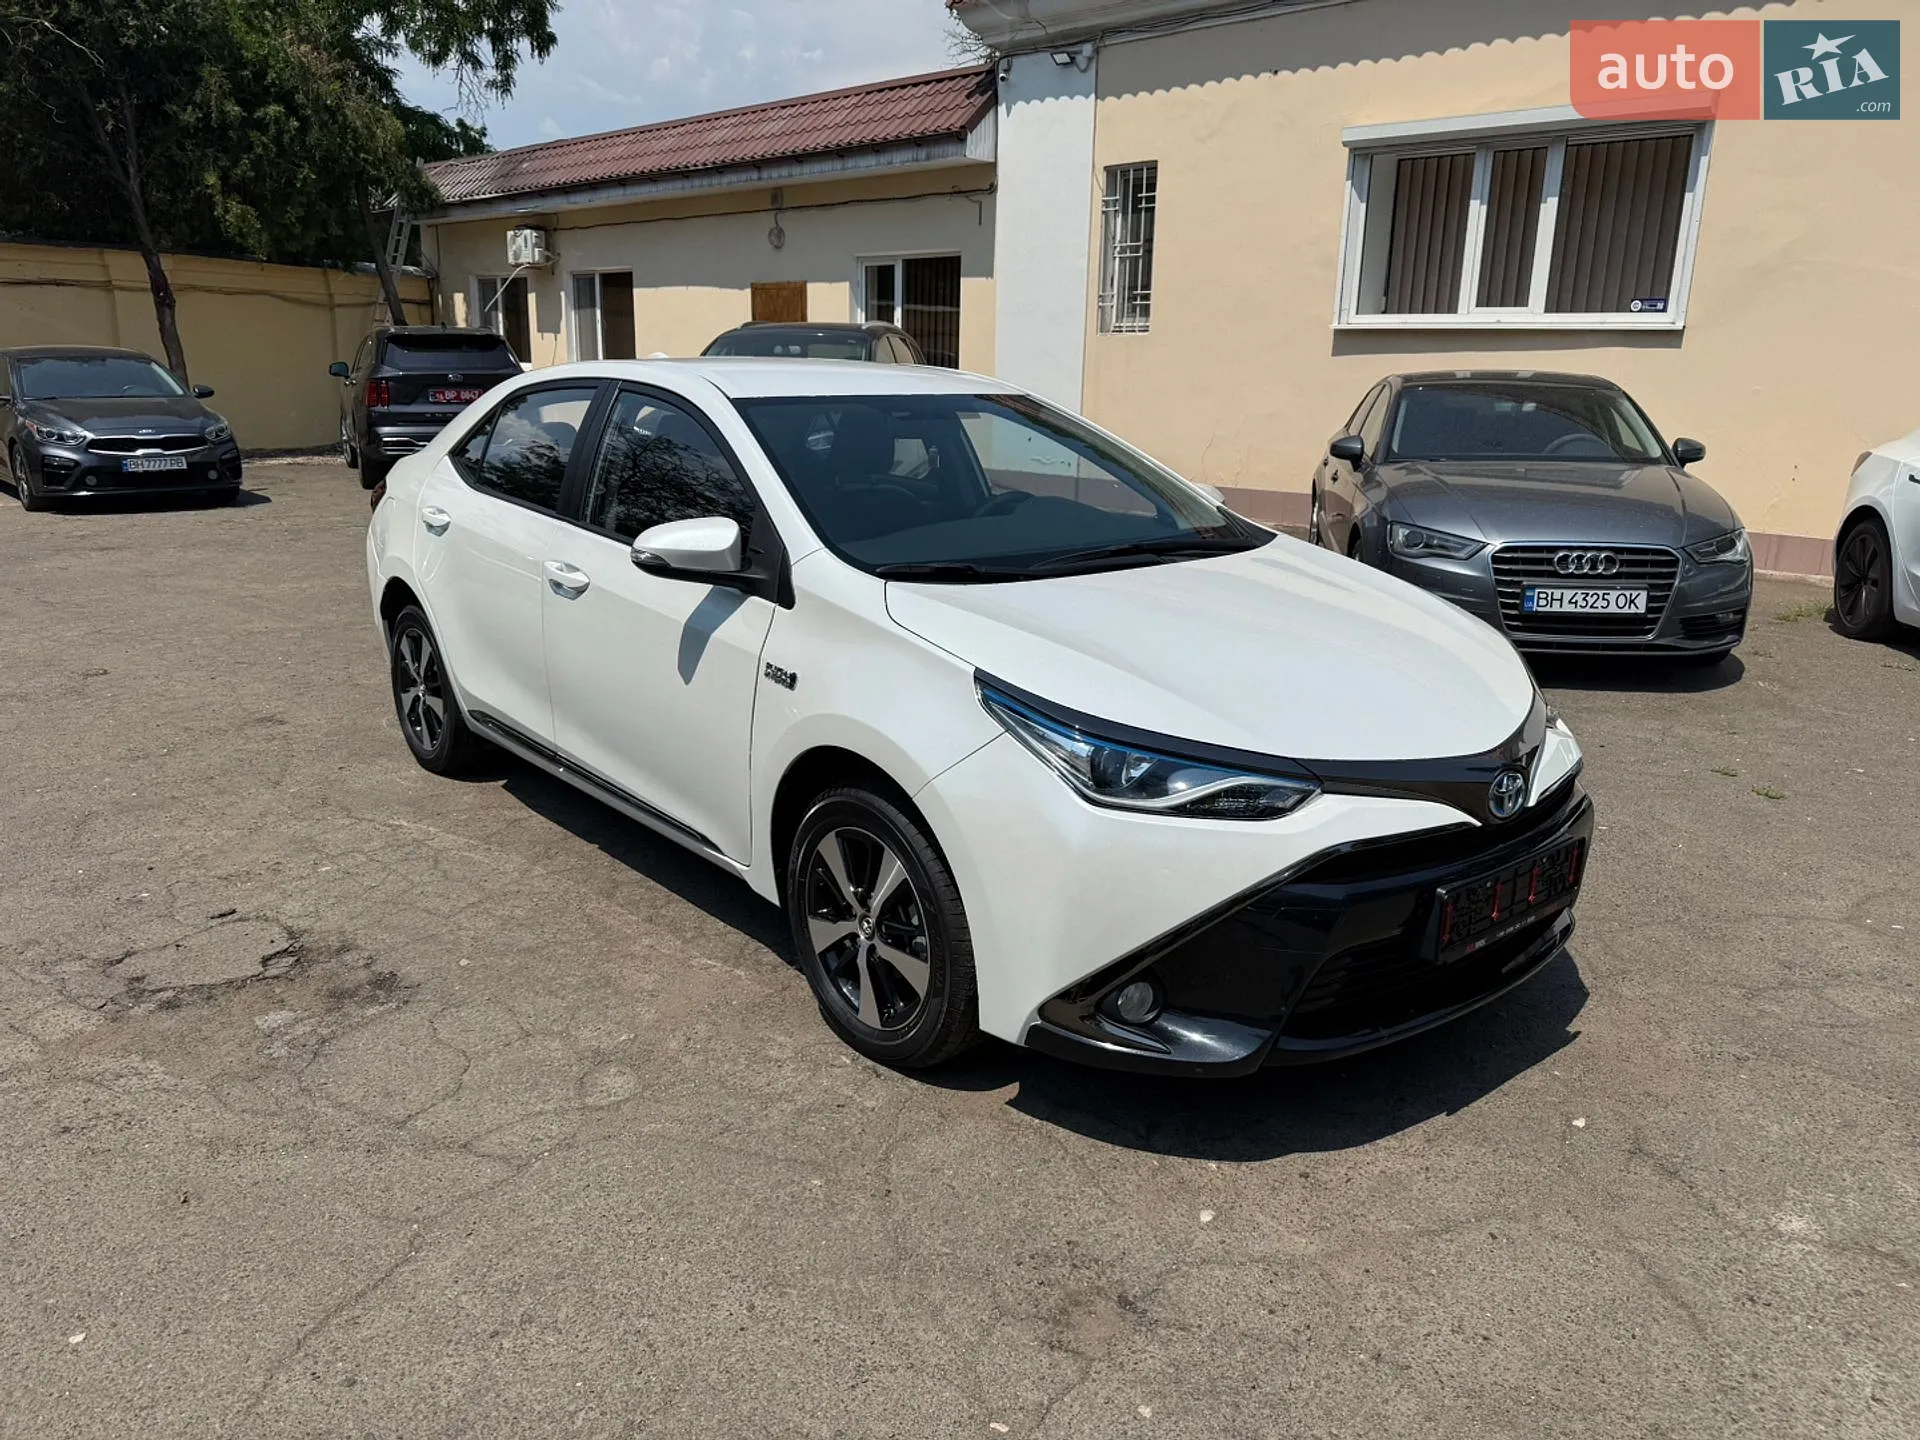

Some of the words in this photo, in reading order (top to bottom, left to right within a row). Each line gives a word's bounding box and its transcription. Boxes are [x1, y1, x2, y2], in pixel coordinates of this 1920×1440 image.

[1536, 591, 1564, 608] BH
[1568, 592, 1611, 609] 4325
[1615, 592, 1642, 610] OK
